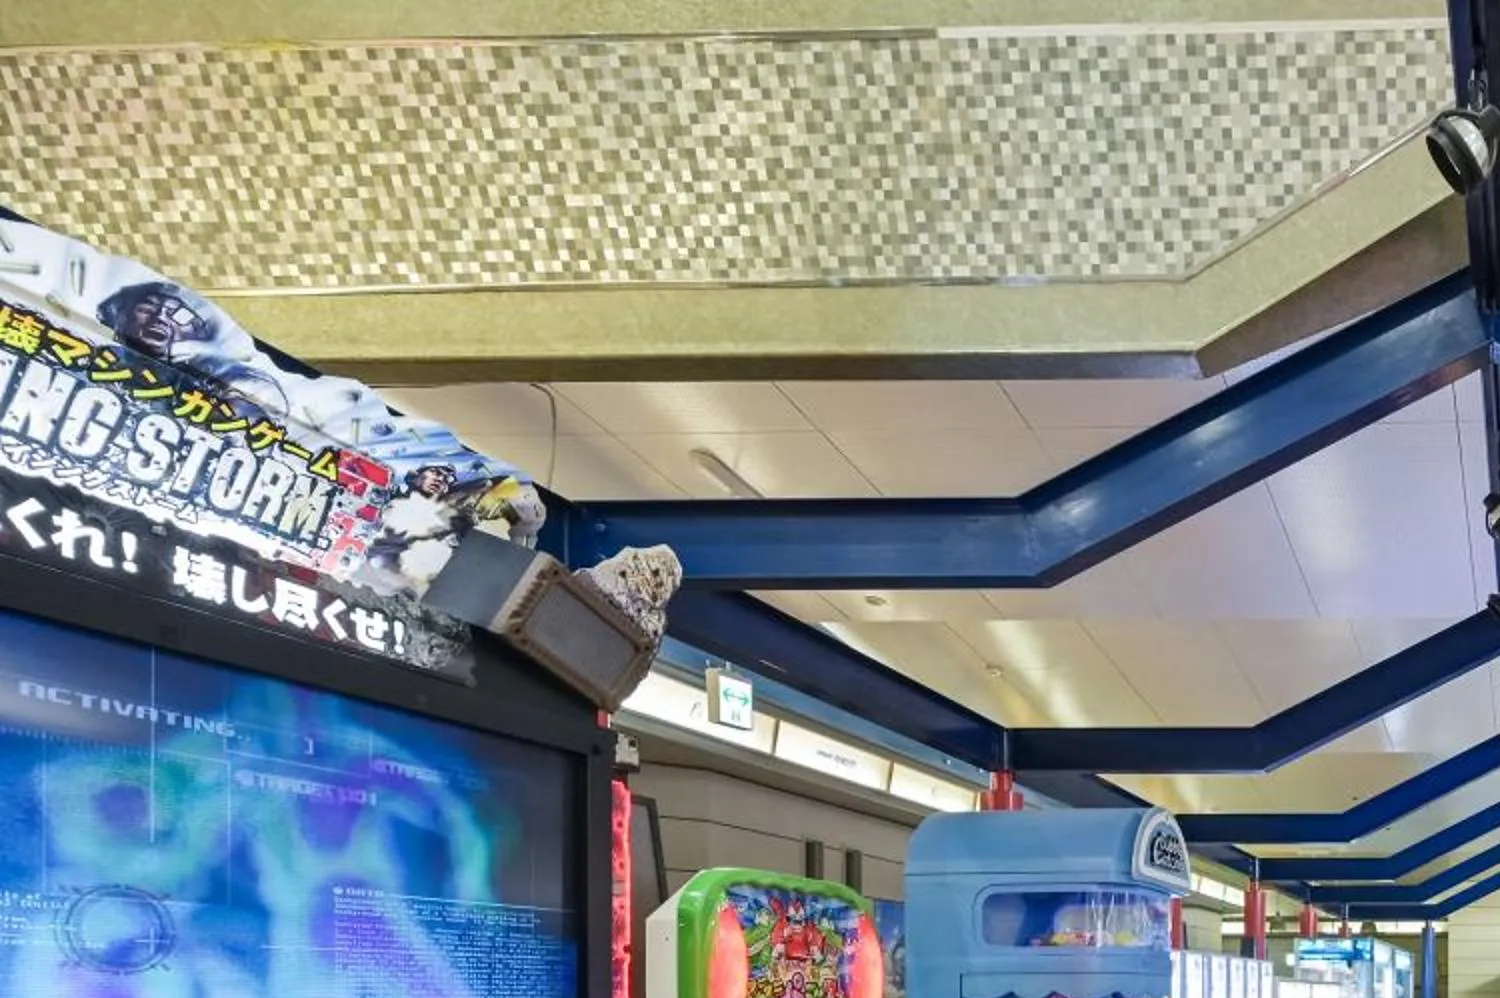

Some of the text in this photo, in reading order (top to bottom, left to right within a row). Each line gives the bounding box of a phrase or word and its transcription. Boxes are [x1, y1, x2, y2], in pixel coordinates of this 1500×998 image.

[126, 412, 333, 537] STORM
[172, 545, 406, 655] 壊し尽くせ!
